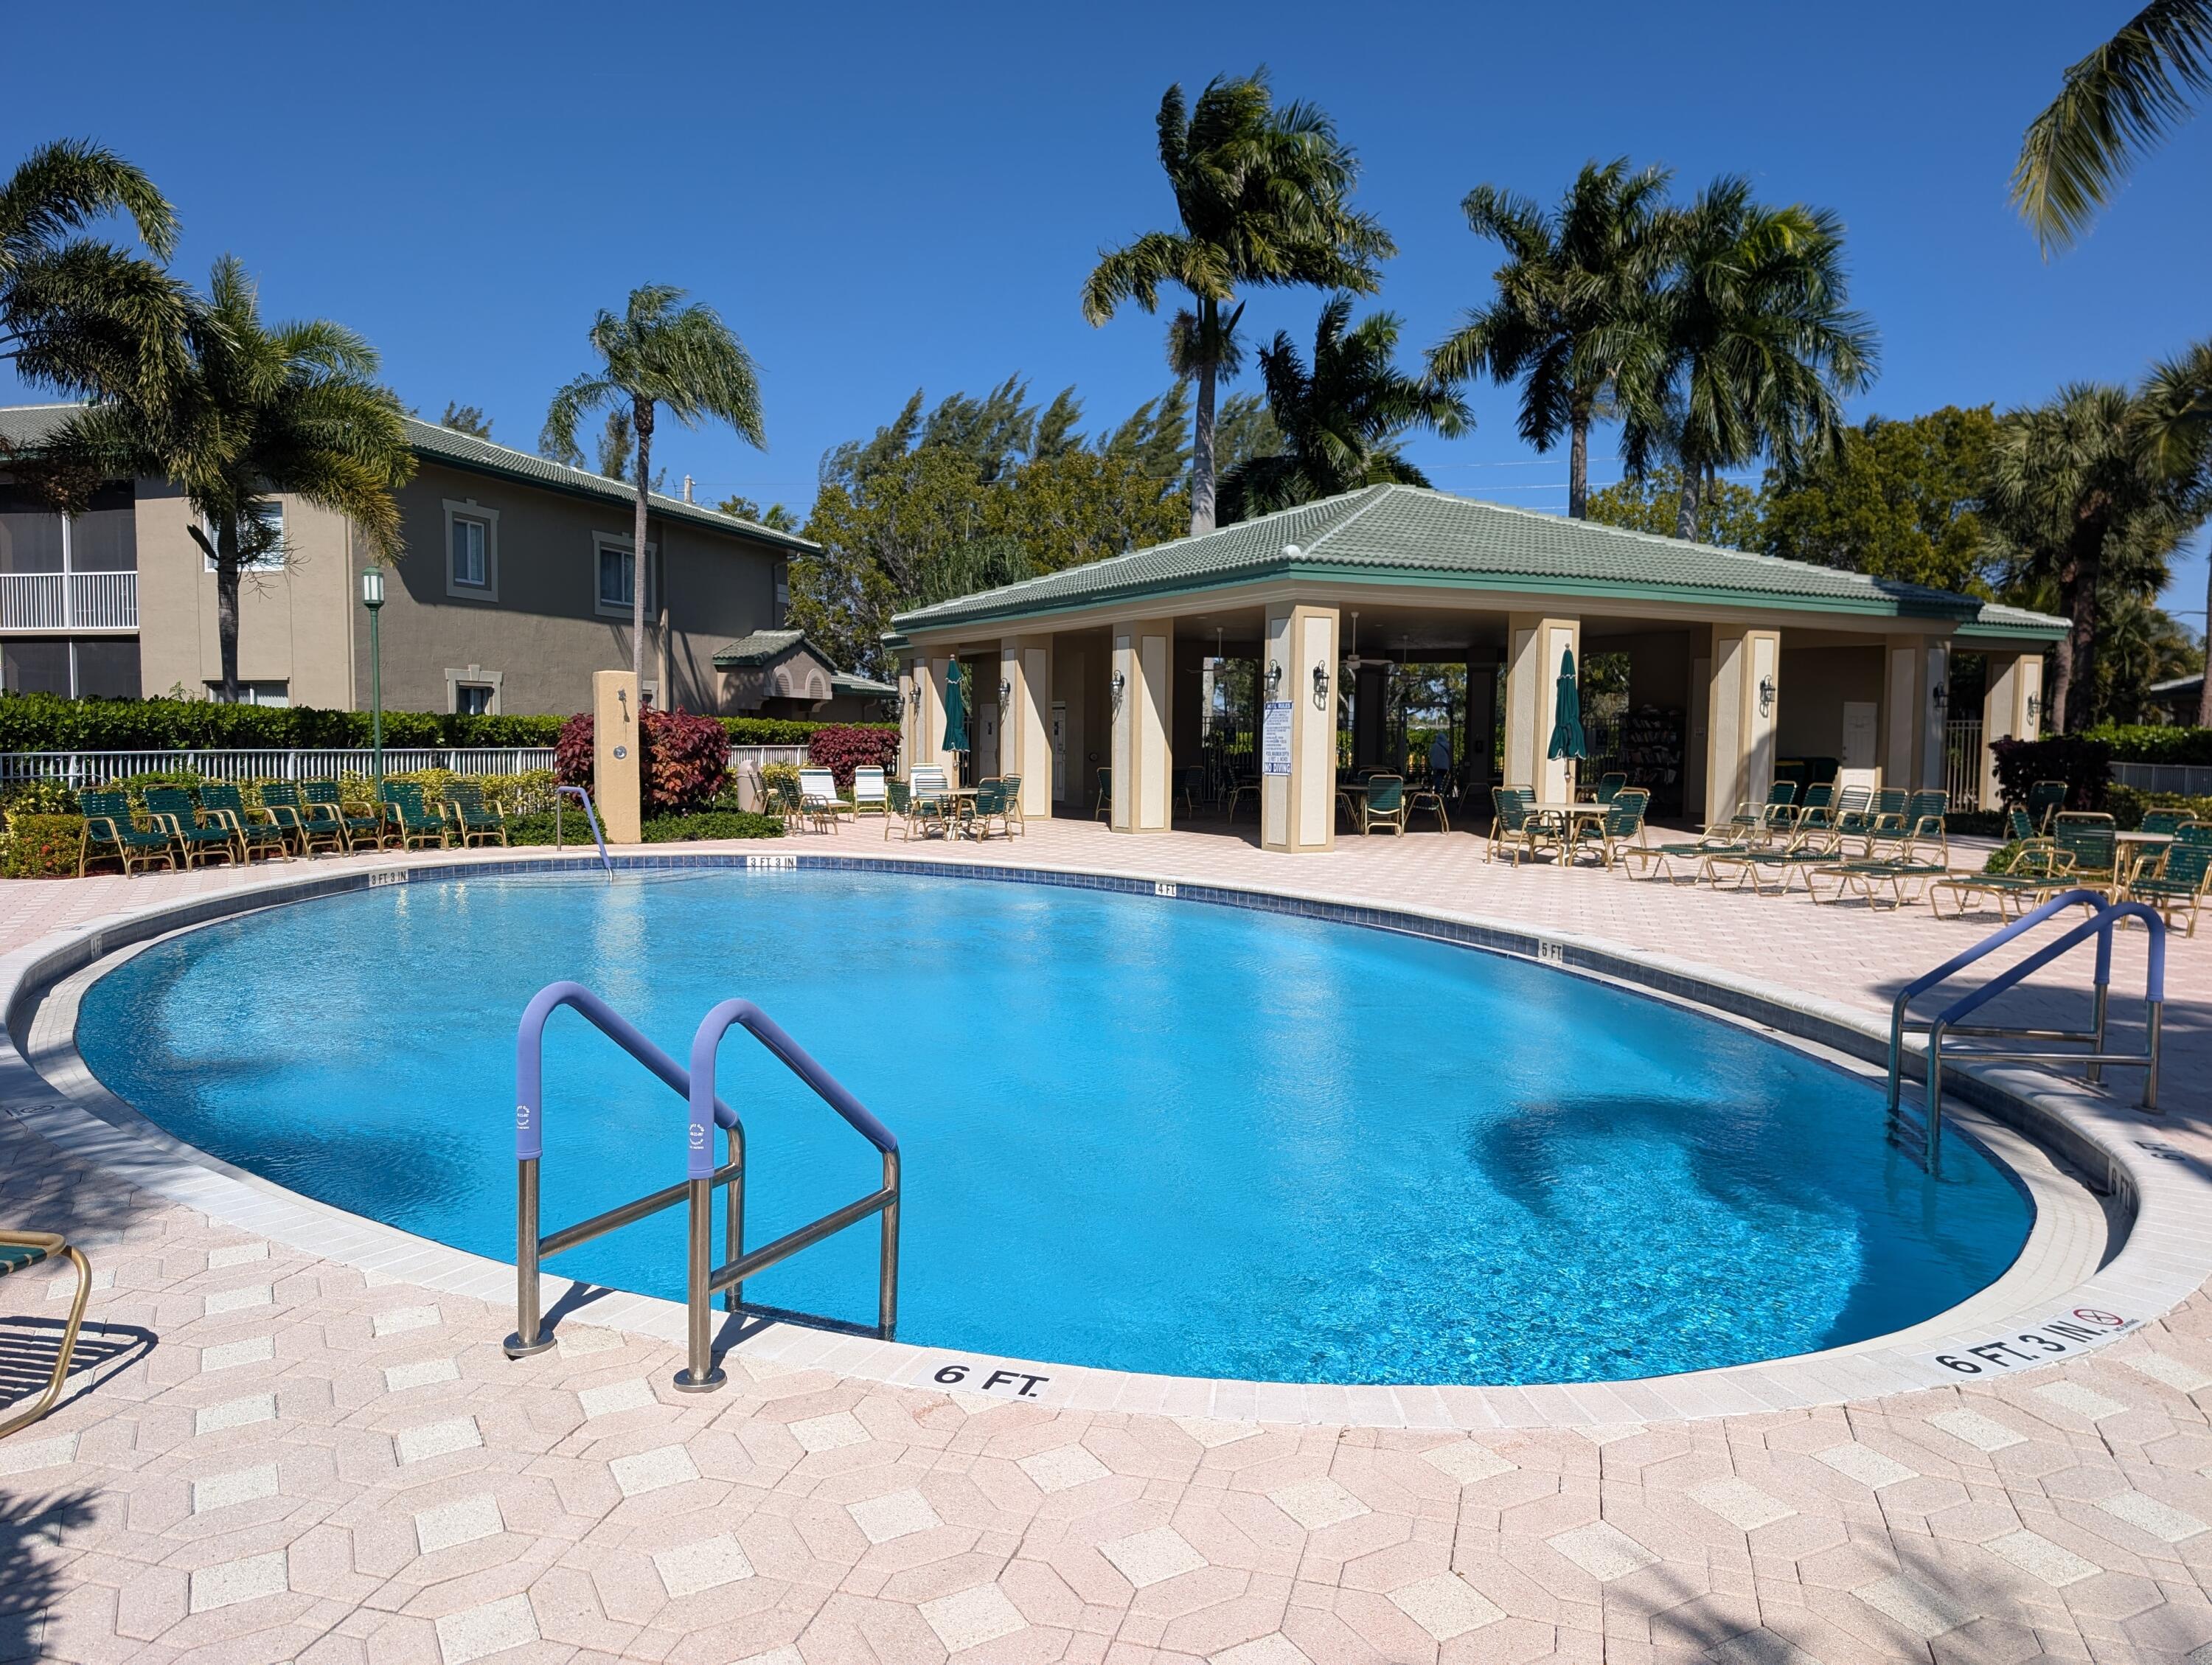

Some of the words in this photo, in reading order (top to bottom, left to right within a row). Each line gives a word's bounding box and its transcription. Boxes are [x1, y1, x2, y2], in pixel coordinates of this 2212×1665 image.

[1265, 763, 1272, 772] NO
[1273, 763, 1290, 773] DIVING
[751, 858, 757, 866] 3
[776, 858, 781, 866] 3
[372, 875, 376, 885] 3
[391, 872, 395, 882] 3
[1158, 883, 1163, 894] 4
[1542, 942, 1548, 957] 5
[1551, 944, 1562, 960] FT.
[2112, 1167, 2117, 1196] 6
[1935, 1355, 1982, 1374] 6
[1966, 1341, 2041, 1367] FT.
[2018, 1335, 2066, 1352] 3
[2042, 1321, 2109, 1343] IN.
[934, 1366, 970, 1384] 6
[981, 1370, 1050, 1397] FT.
